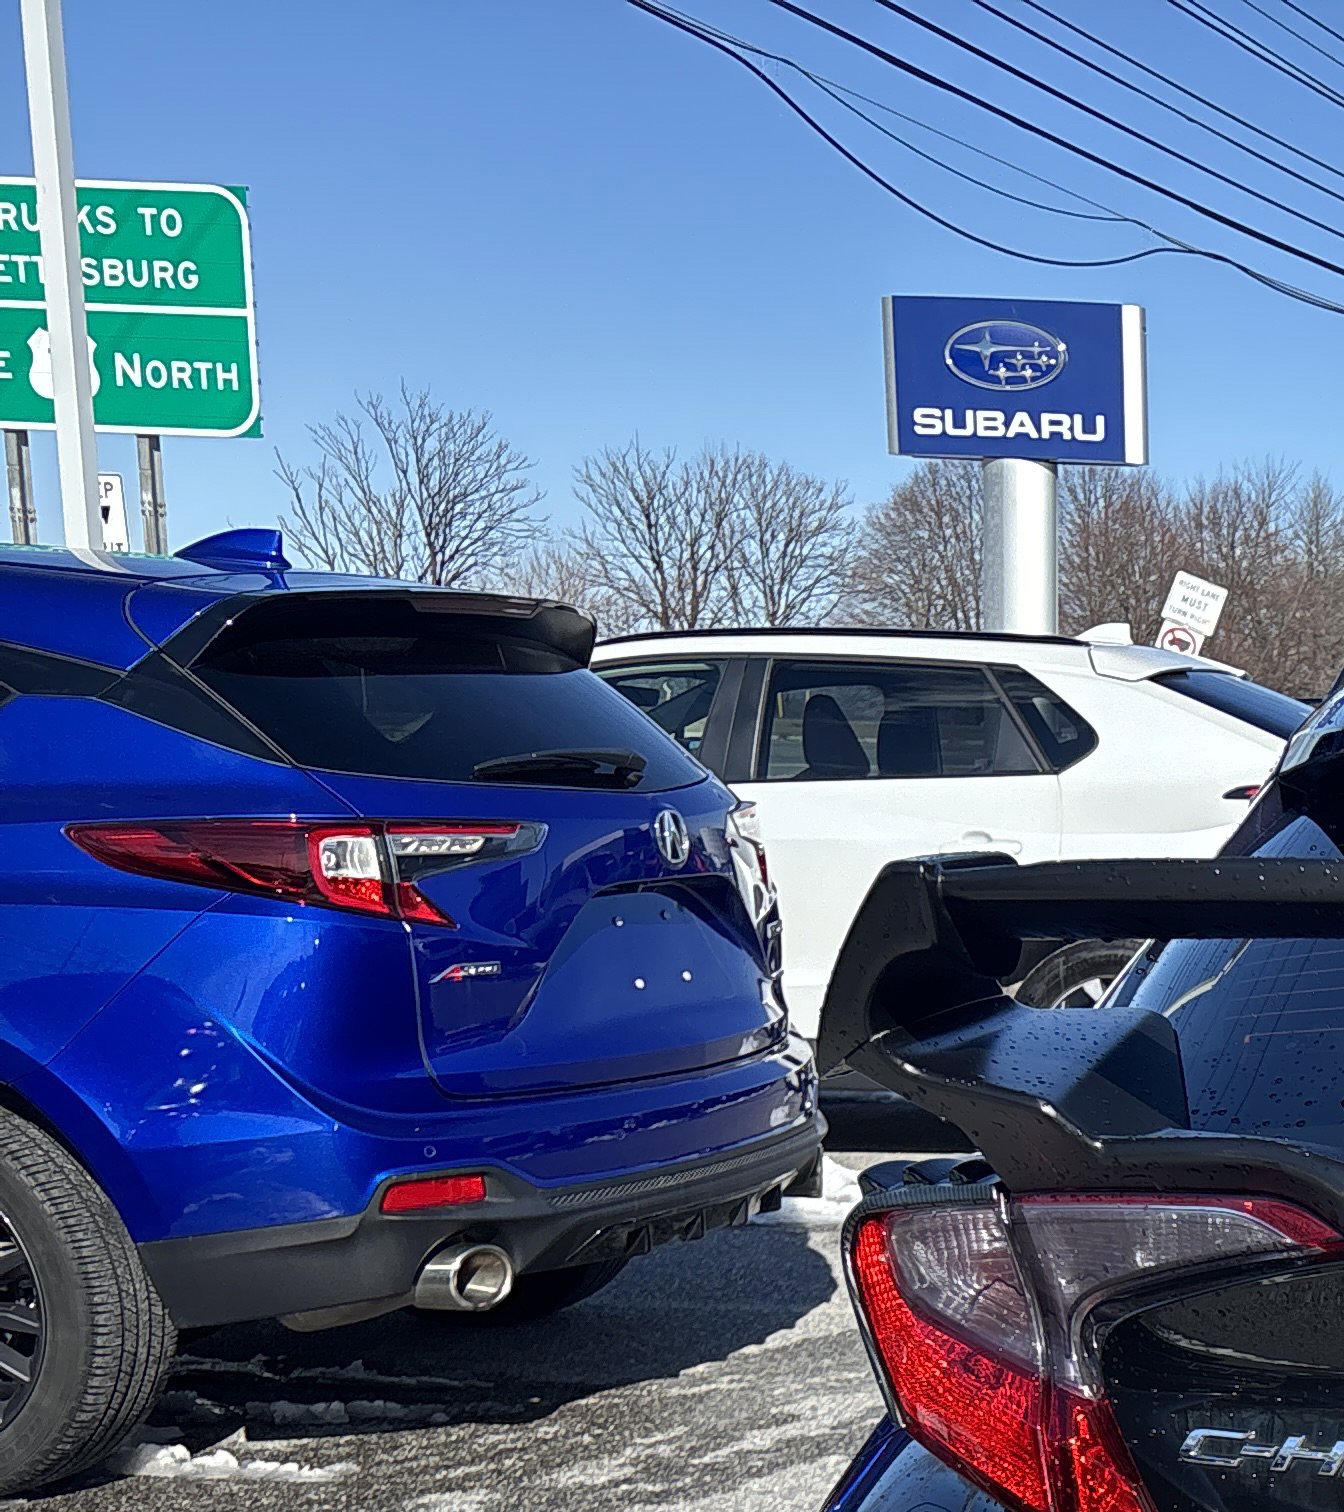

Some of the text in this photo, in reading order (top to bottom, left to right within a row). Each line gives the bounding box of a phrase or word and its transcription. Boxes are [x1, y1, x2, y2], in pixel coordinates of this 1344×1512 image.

[137, 207, 183, 237] TO
[114, 352, 239, 391] NORTH
[913, 407, 1105, 441] SUBARU
[1179, 580, 1220, 602] RIGHT LANE
[1181, 595, 1208, 612] MUST
[1169, 605, 1188, 617] TURN
